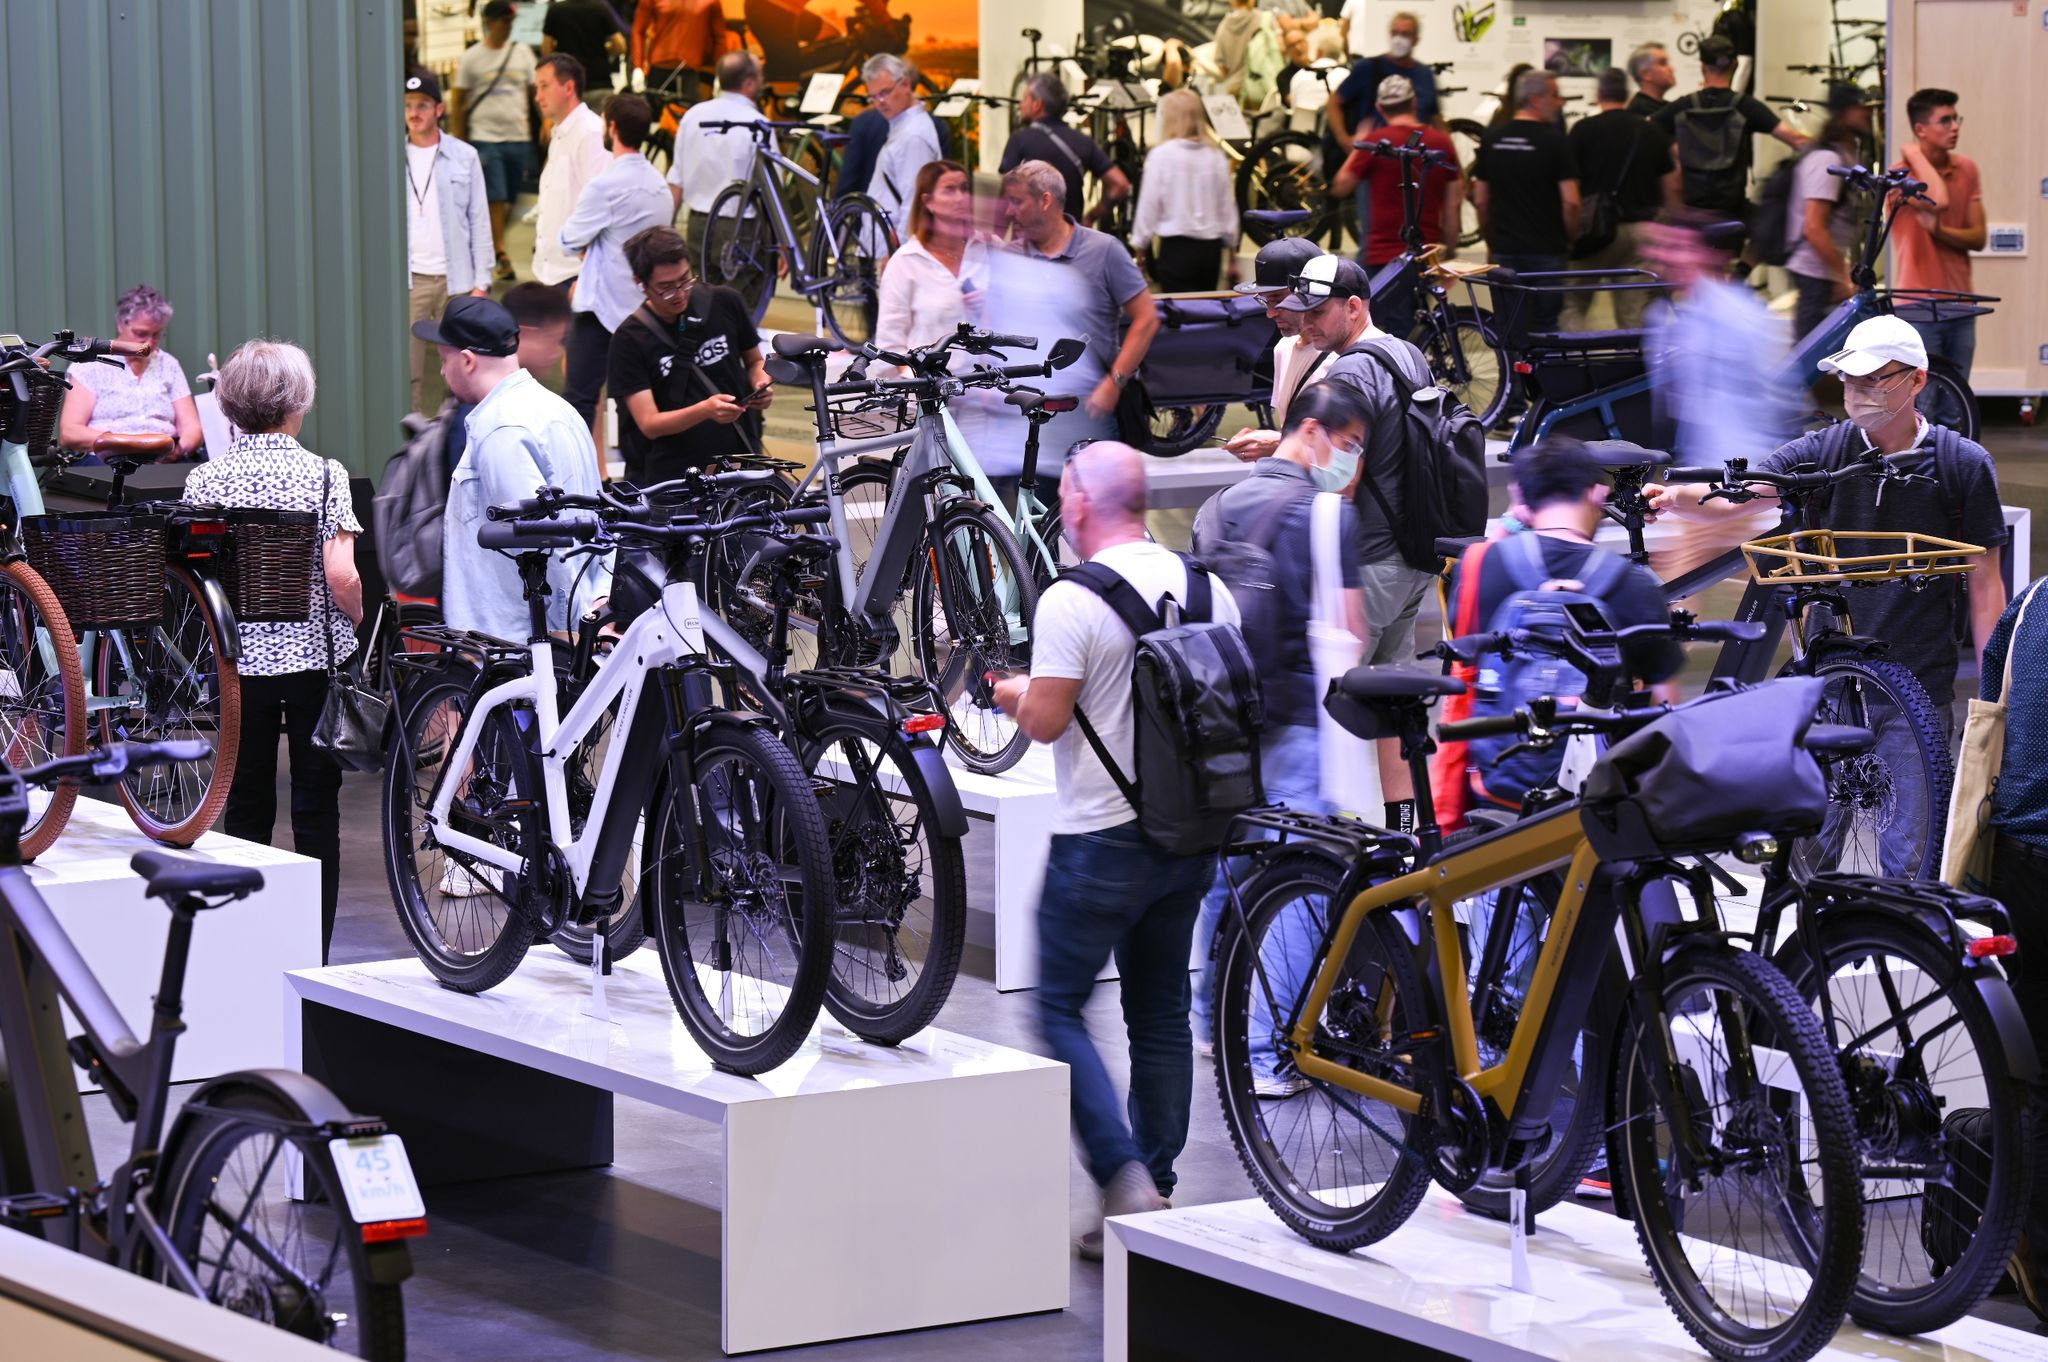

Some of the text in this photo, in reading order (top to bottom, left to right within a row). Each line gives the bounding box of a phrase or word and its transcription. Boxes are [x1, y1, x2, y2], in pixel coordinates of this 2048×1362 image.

[1400, 803, 1411, 834] STRONG
[355, 1149, 391, 1172] 45
[359, 1182, 405, 1198] km/h
